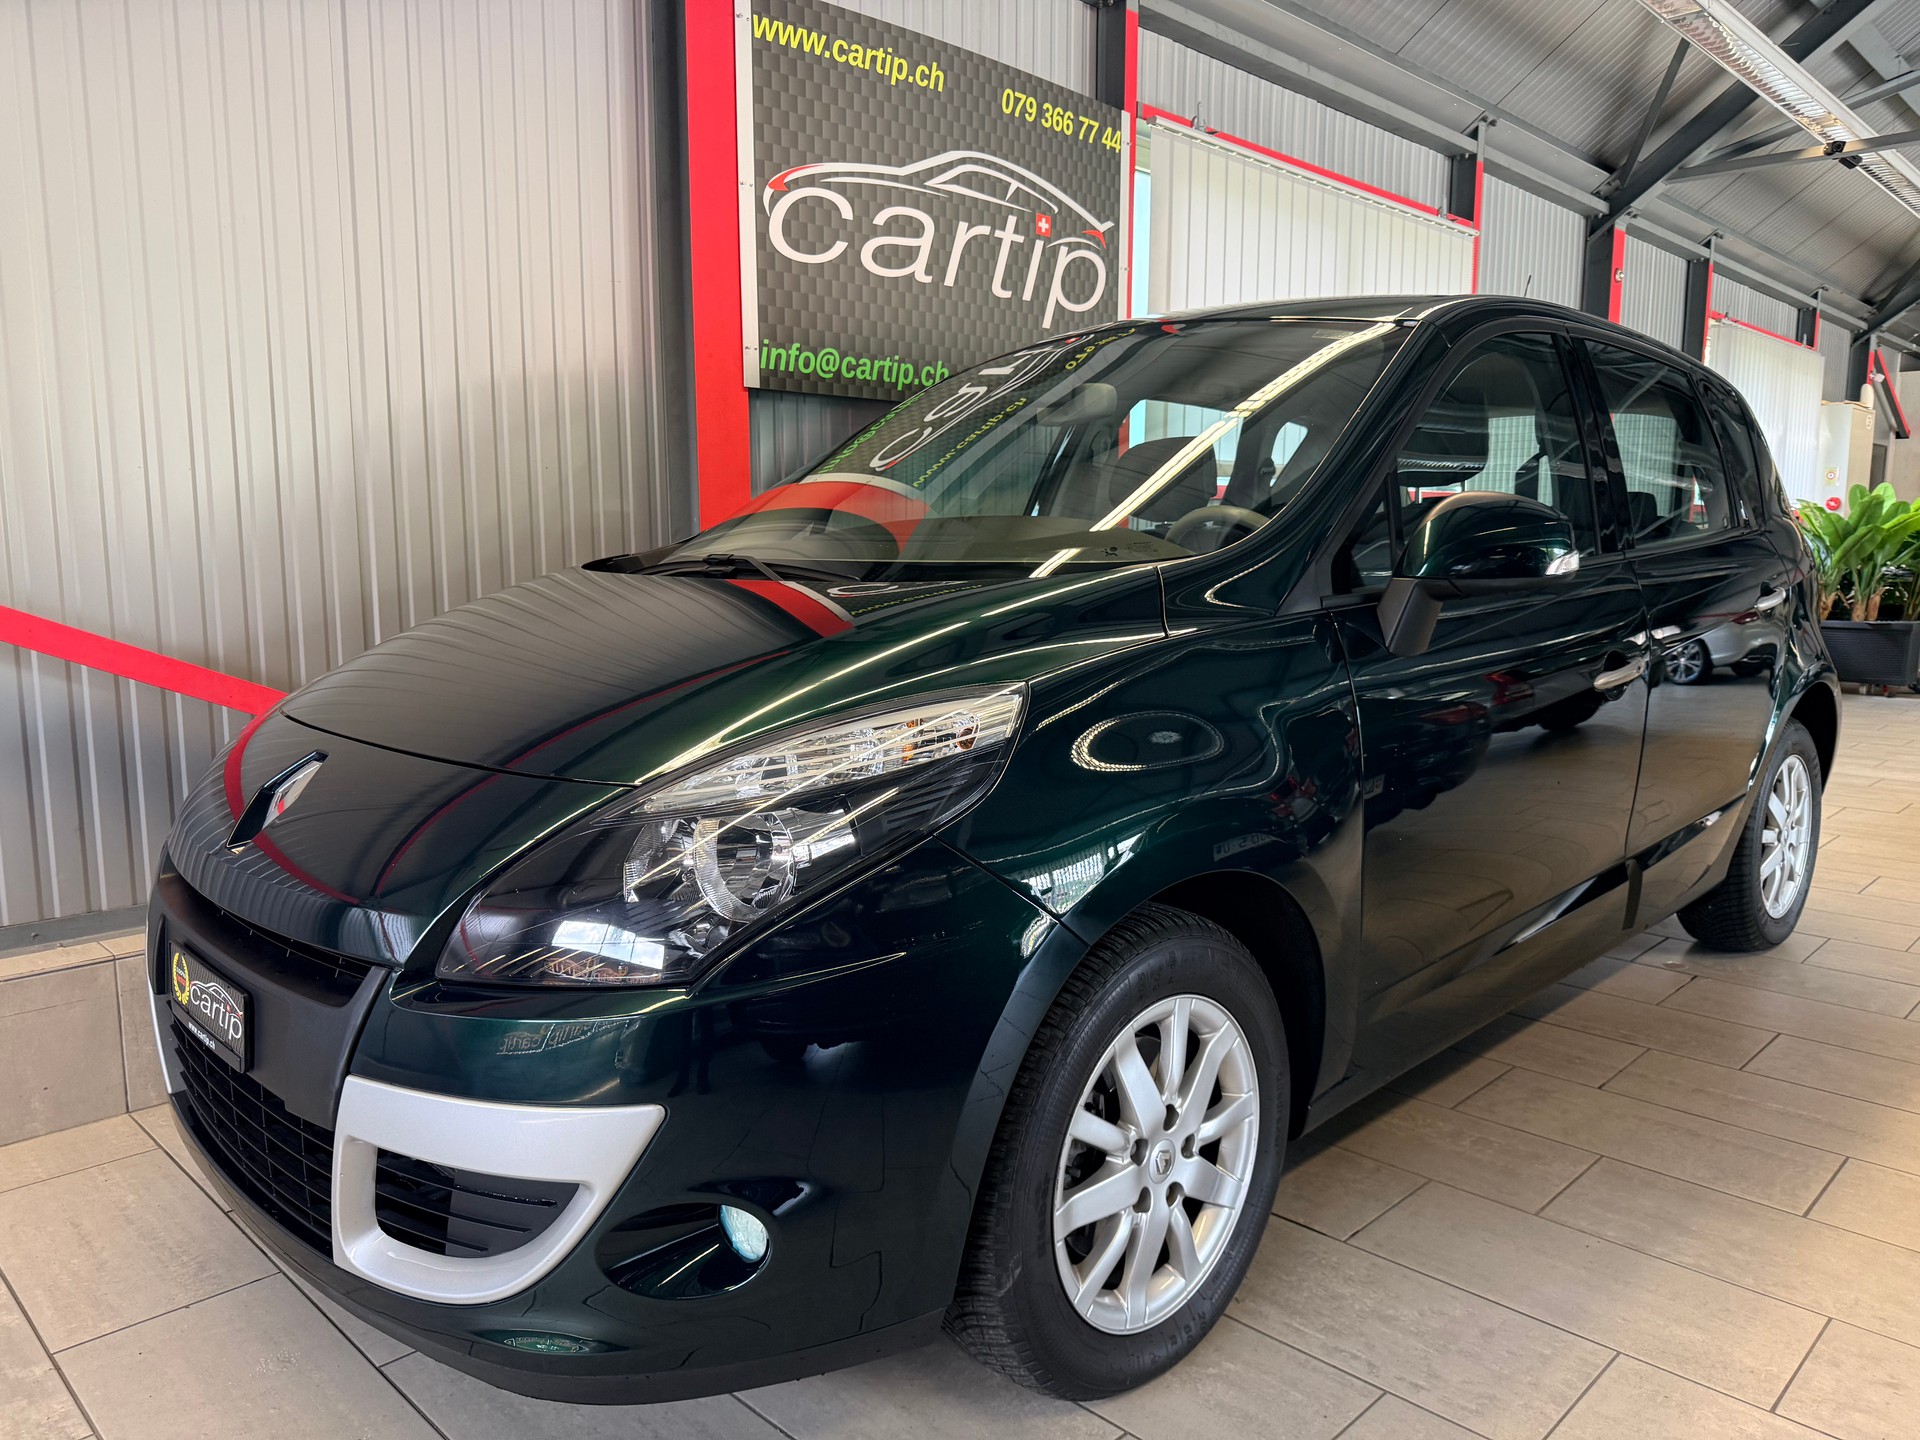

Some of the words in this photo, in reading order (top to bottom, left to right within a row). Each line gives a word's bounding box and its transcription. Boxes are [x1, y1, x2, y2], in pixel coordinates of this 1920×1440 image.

[752, 15, 945, 93] www.cartip.ch
[1001, 87, 1037, 122] 079
[1041, 102, 1074, 136] 366
[1078, 115, 1100, 144] 77
[1101, 126, 1121, 154] 44
[768, 187, 1107, 330] cartip
[760, 339, 949, 391] info@cartip.ch
[190, 985, 242, 1040] cartip
